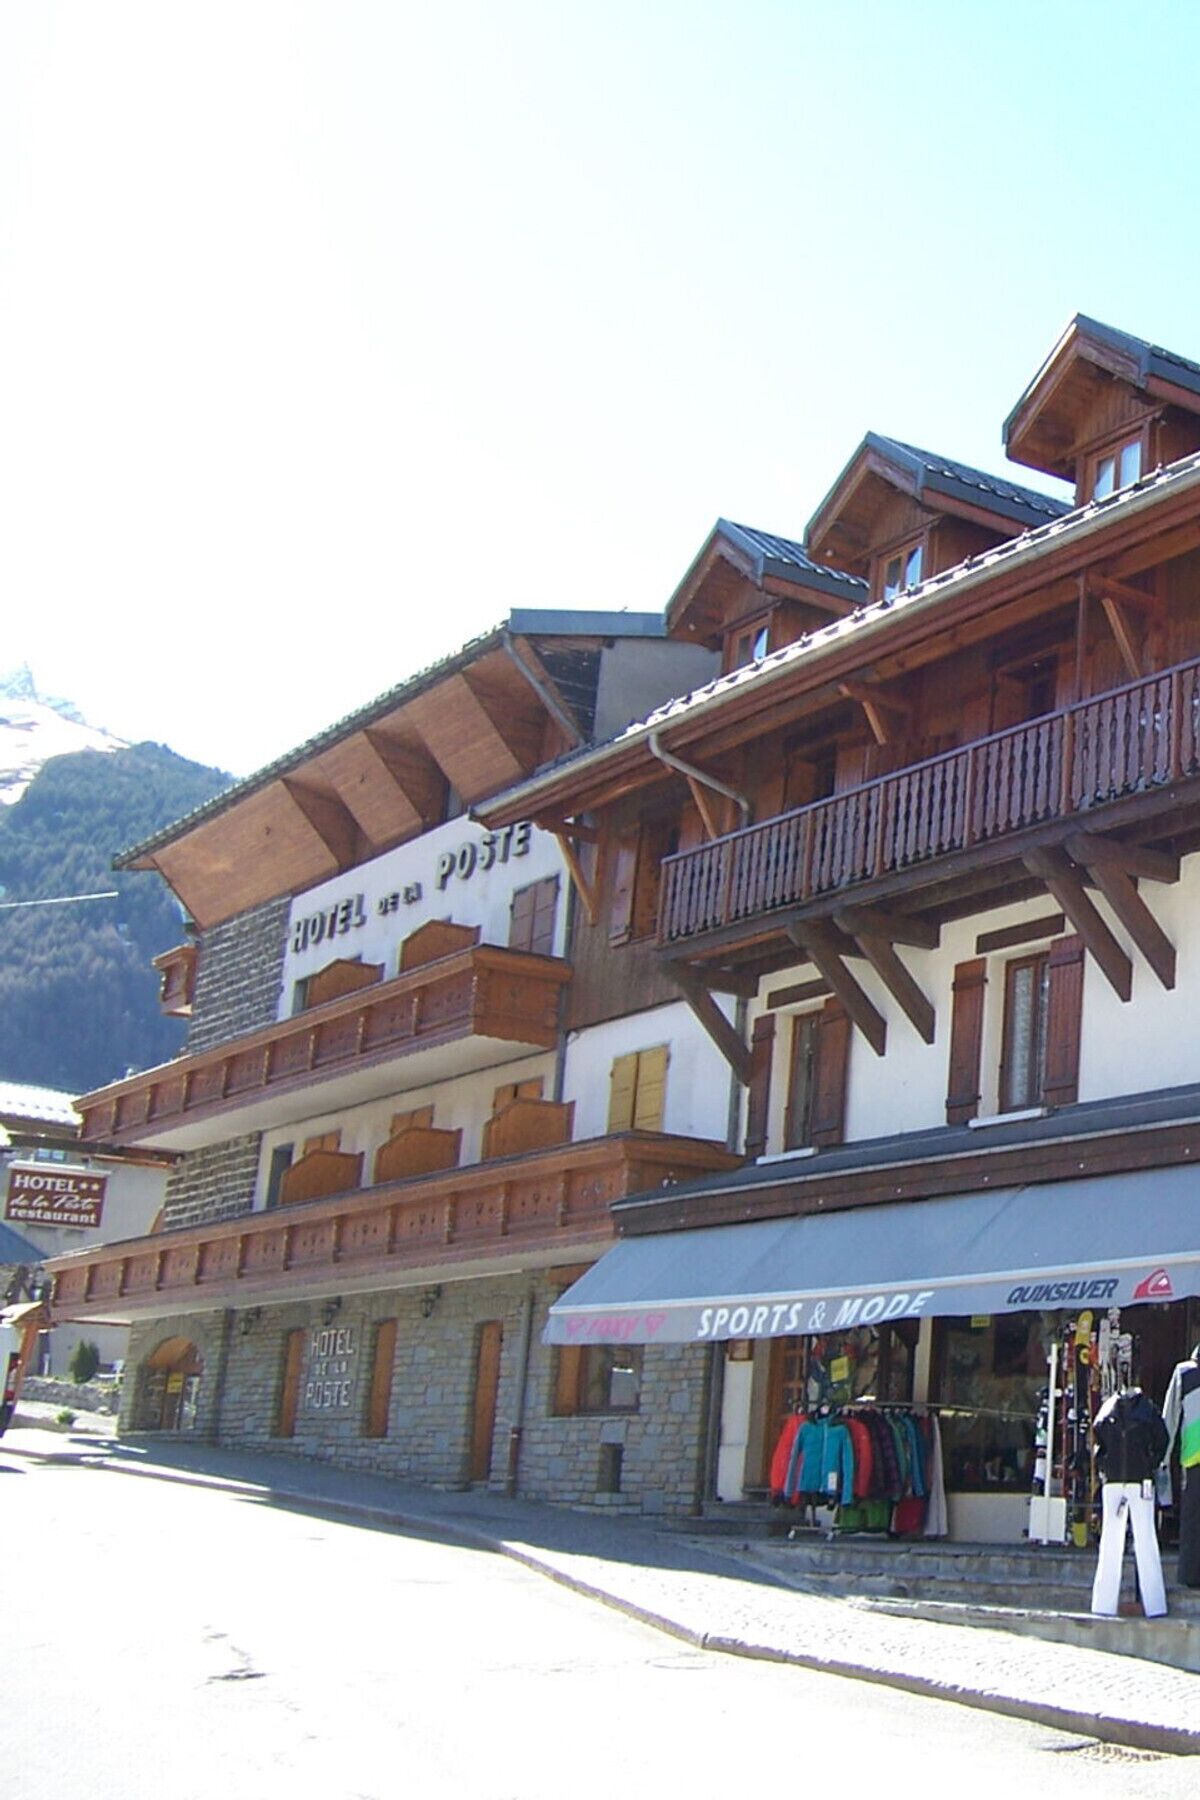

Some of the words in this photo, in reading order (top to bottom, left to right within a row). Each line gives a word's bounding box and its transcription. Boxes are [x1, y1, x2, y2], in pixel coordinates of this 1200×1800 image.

[291, 893, 367, 953] HOTEL
[377, 892, 399, 916] DE
[403, 882, 422, 905] LA
[436, 821, 531, 890] POSTE
[14, 1174, 79, 1193] HOTEL
[9, 1207, 97, 1223] restaurant
[1007, 1278, 1120, 1304] QUIKSILVER
[697, 1302, 803, 1338] SPORTS
[808, 1302, 826, 1330] &
[833, 1291, 935, 1326] MODE
[312, 1329, 354, 1360] HOTEL
[306, 1380, 351, 1409] POSTE
